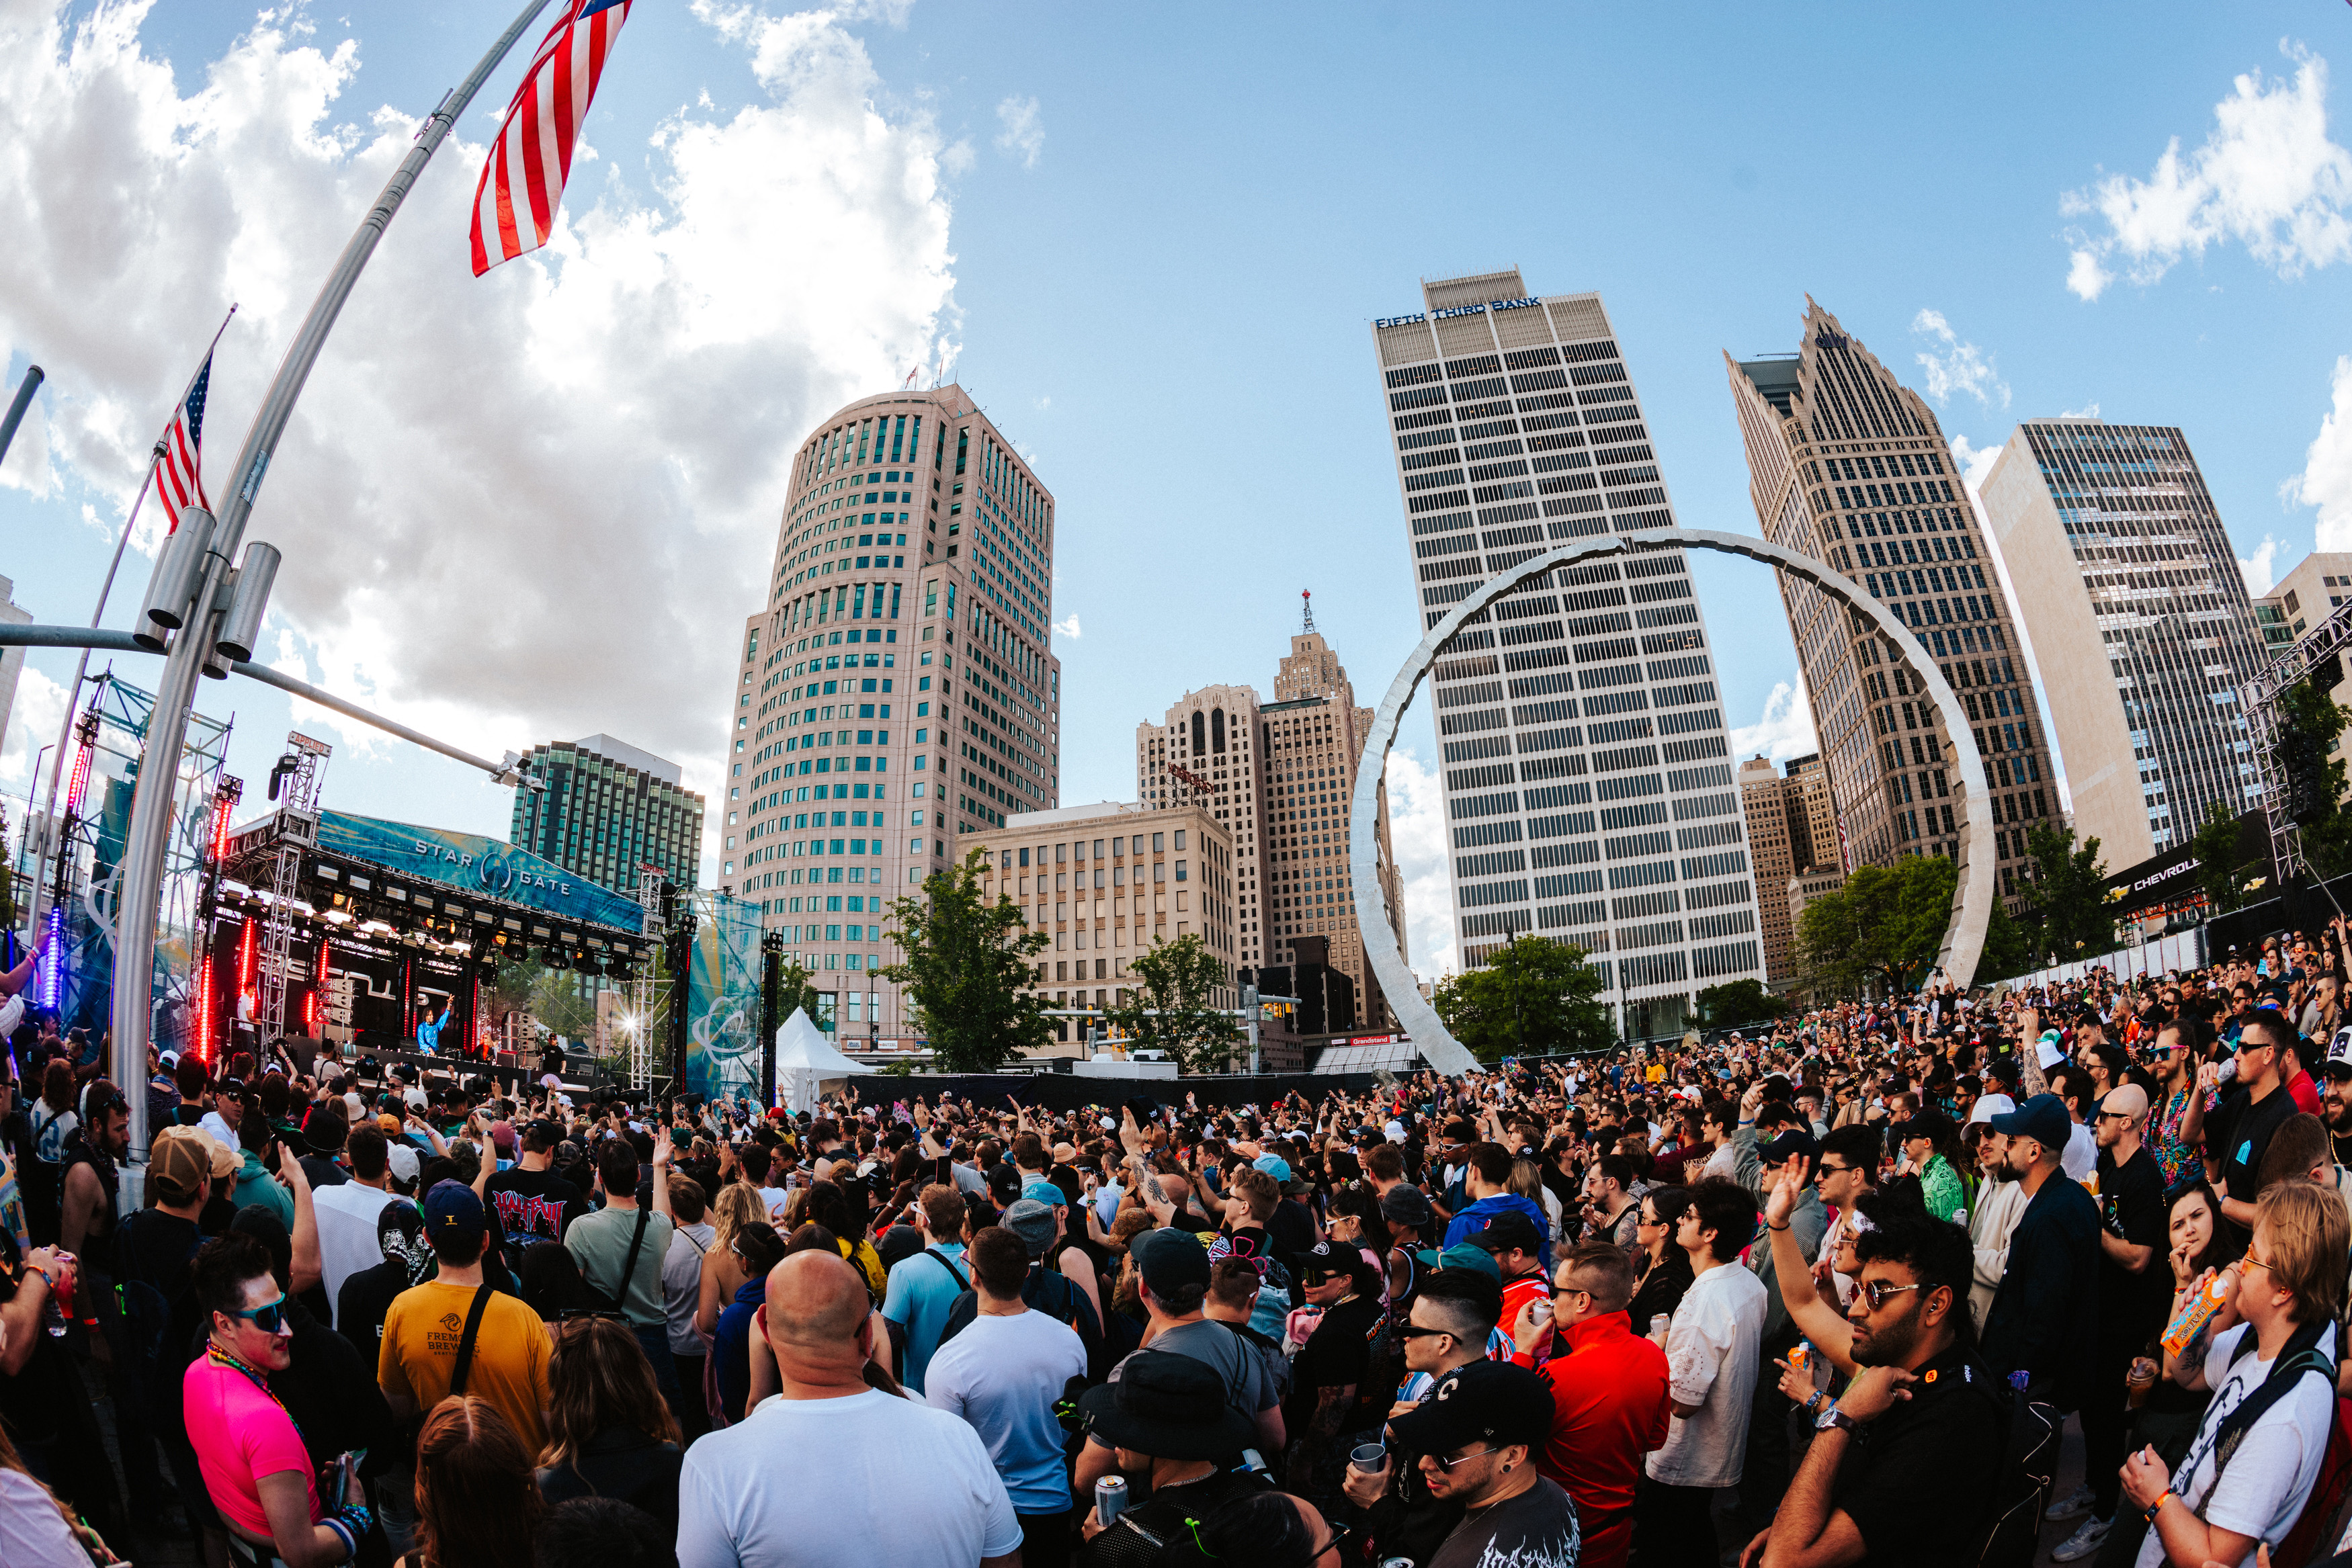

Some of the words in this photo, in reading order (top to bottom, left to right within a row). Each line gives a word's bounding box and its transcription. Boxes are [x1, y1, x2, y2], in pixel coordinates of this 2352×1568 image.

[1375, 313, 1426, 329] FIFTH
[1431, 304, 1486, 320] THIRD
[1490, 297, 1542, 311] BANK
[294, 734, 325, 752] APPLIED
[415, 840, 472, 867] STAR
[519, 872, 571, 896] GATE
[642, 863, 664, 875] APPLIED
[2134, 857, 2206, 891] CHEVROLE
[1353, 1037, 1388, 1045] Grandstand
[2177, 1305, 2208, 1342] BEATBOX
[427, 1332, 480, 1344] FREMOT
[427, 1341, 480, 1353] BREWG
[1437, 1377, 1459, 1401] C
